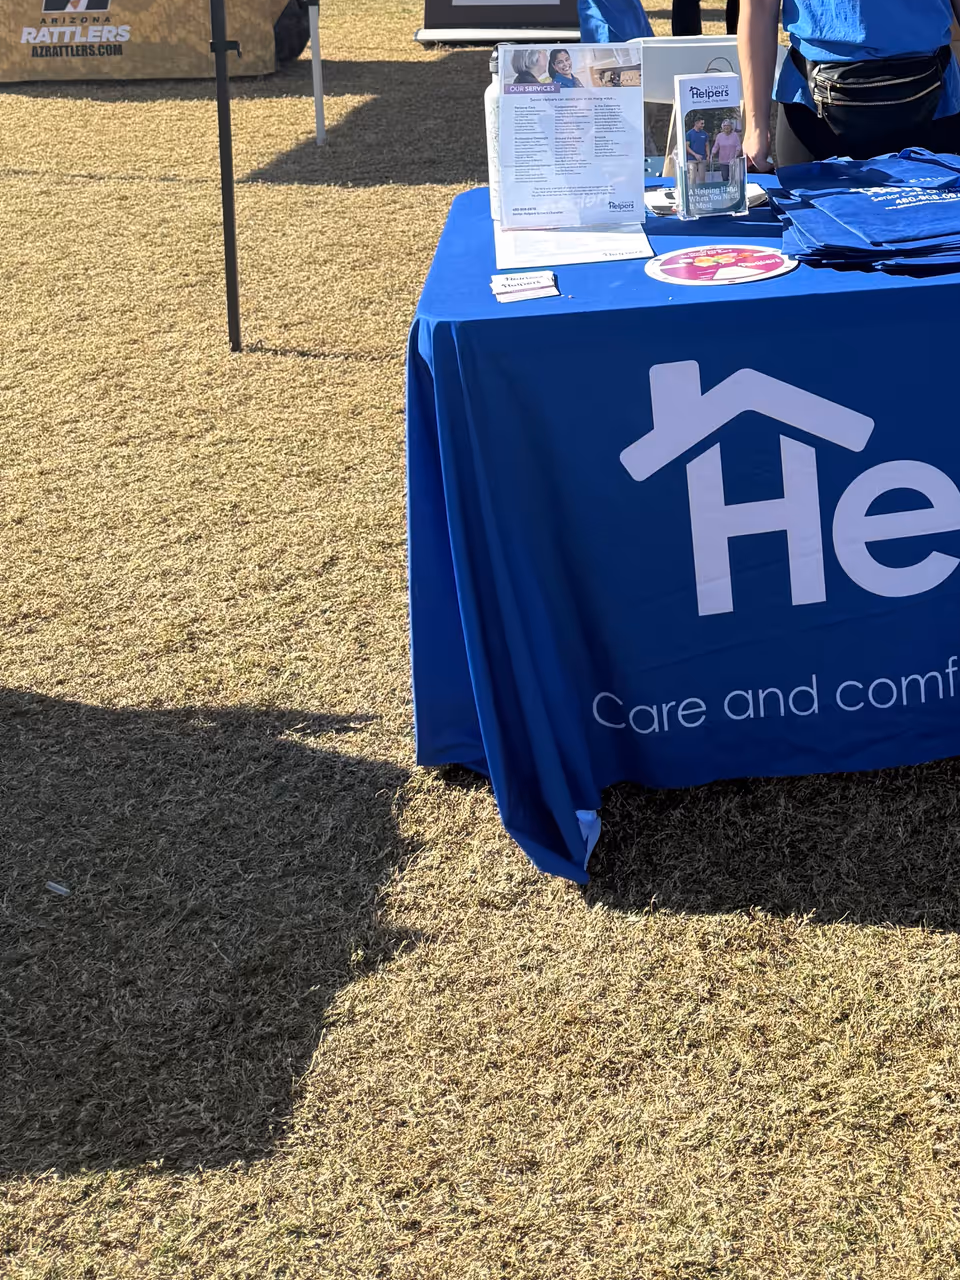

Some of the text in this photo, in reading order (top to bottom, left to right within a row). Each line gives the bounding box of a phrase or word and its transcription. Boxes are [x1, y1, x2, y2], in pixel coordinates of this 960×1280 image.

[20, 25, 132, 44] RATTLERS
[31, 44, 123, 58] AZRATTLERS.COM
[691, 89, 729, 100] Helpers
[689, 192, 739, 203] When You Need
[695, 188, 719, 197] Helping
[871, 193, 900, 202] Senior
[592, 691, 707, 734] Care
[723, 673, 819, 720] and
